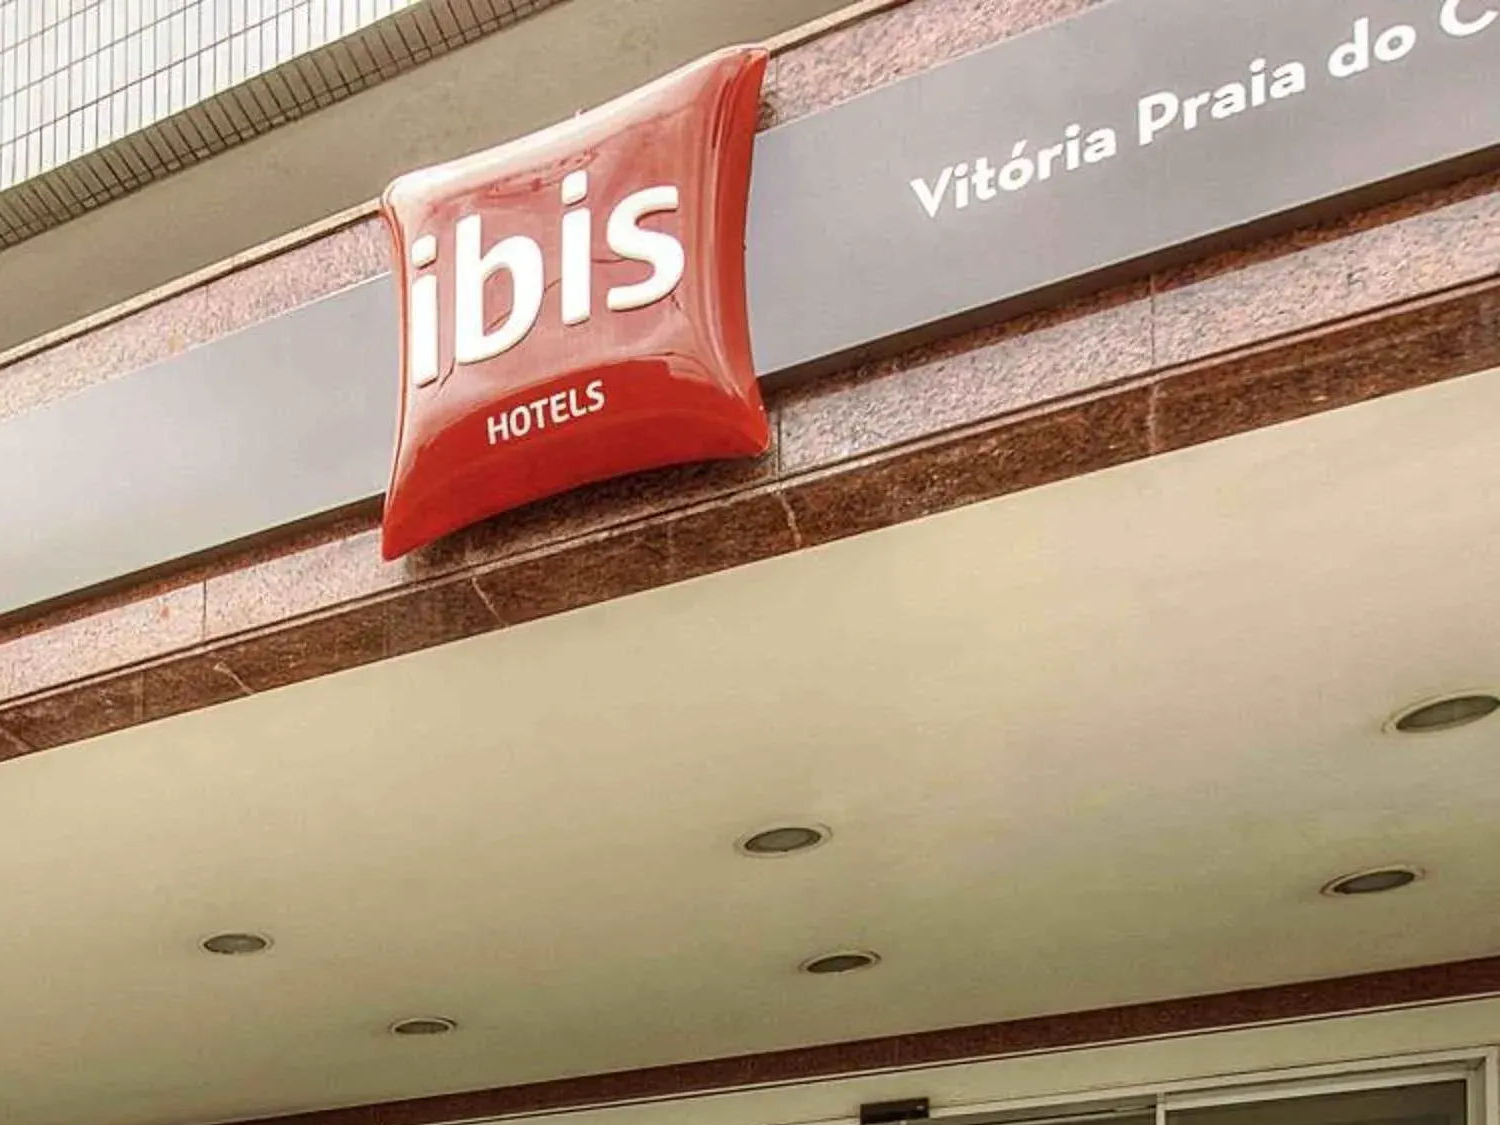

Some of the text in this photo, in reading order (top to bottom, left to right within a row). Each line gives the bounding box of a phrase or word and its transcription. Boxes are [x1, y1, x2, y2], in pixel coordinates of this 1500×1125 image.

[909, 124, 1117, 218] Vitória
[1138, 58, 1306, 145] Praia
[1327, 17, 1416, 78] do
[411, 170, 685, 388] ibis
[487, 380, 606, 444] HOTELS
